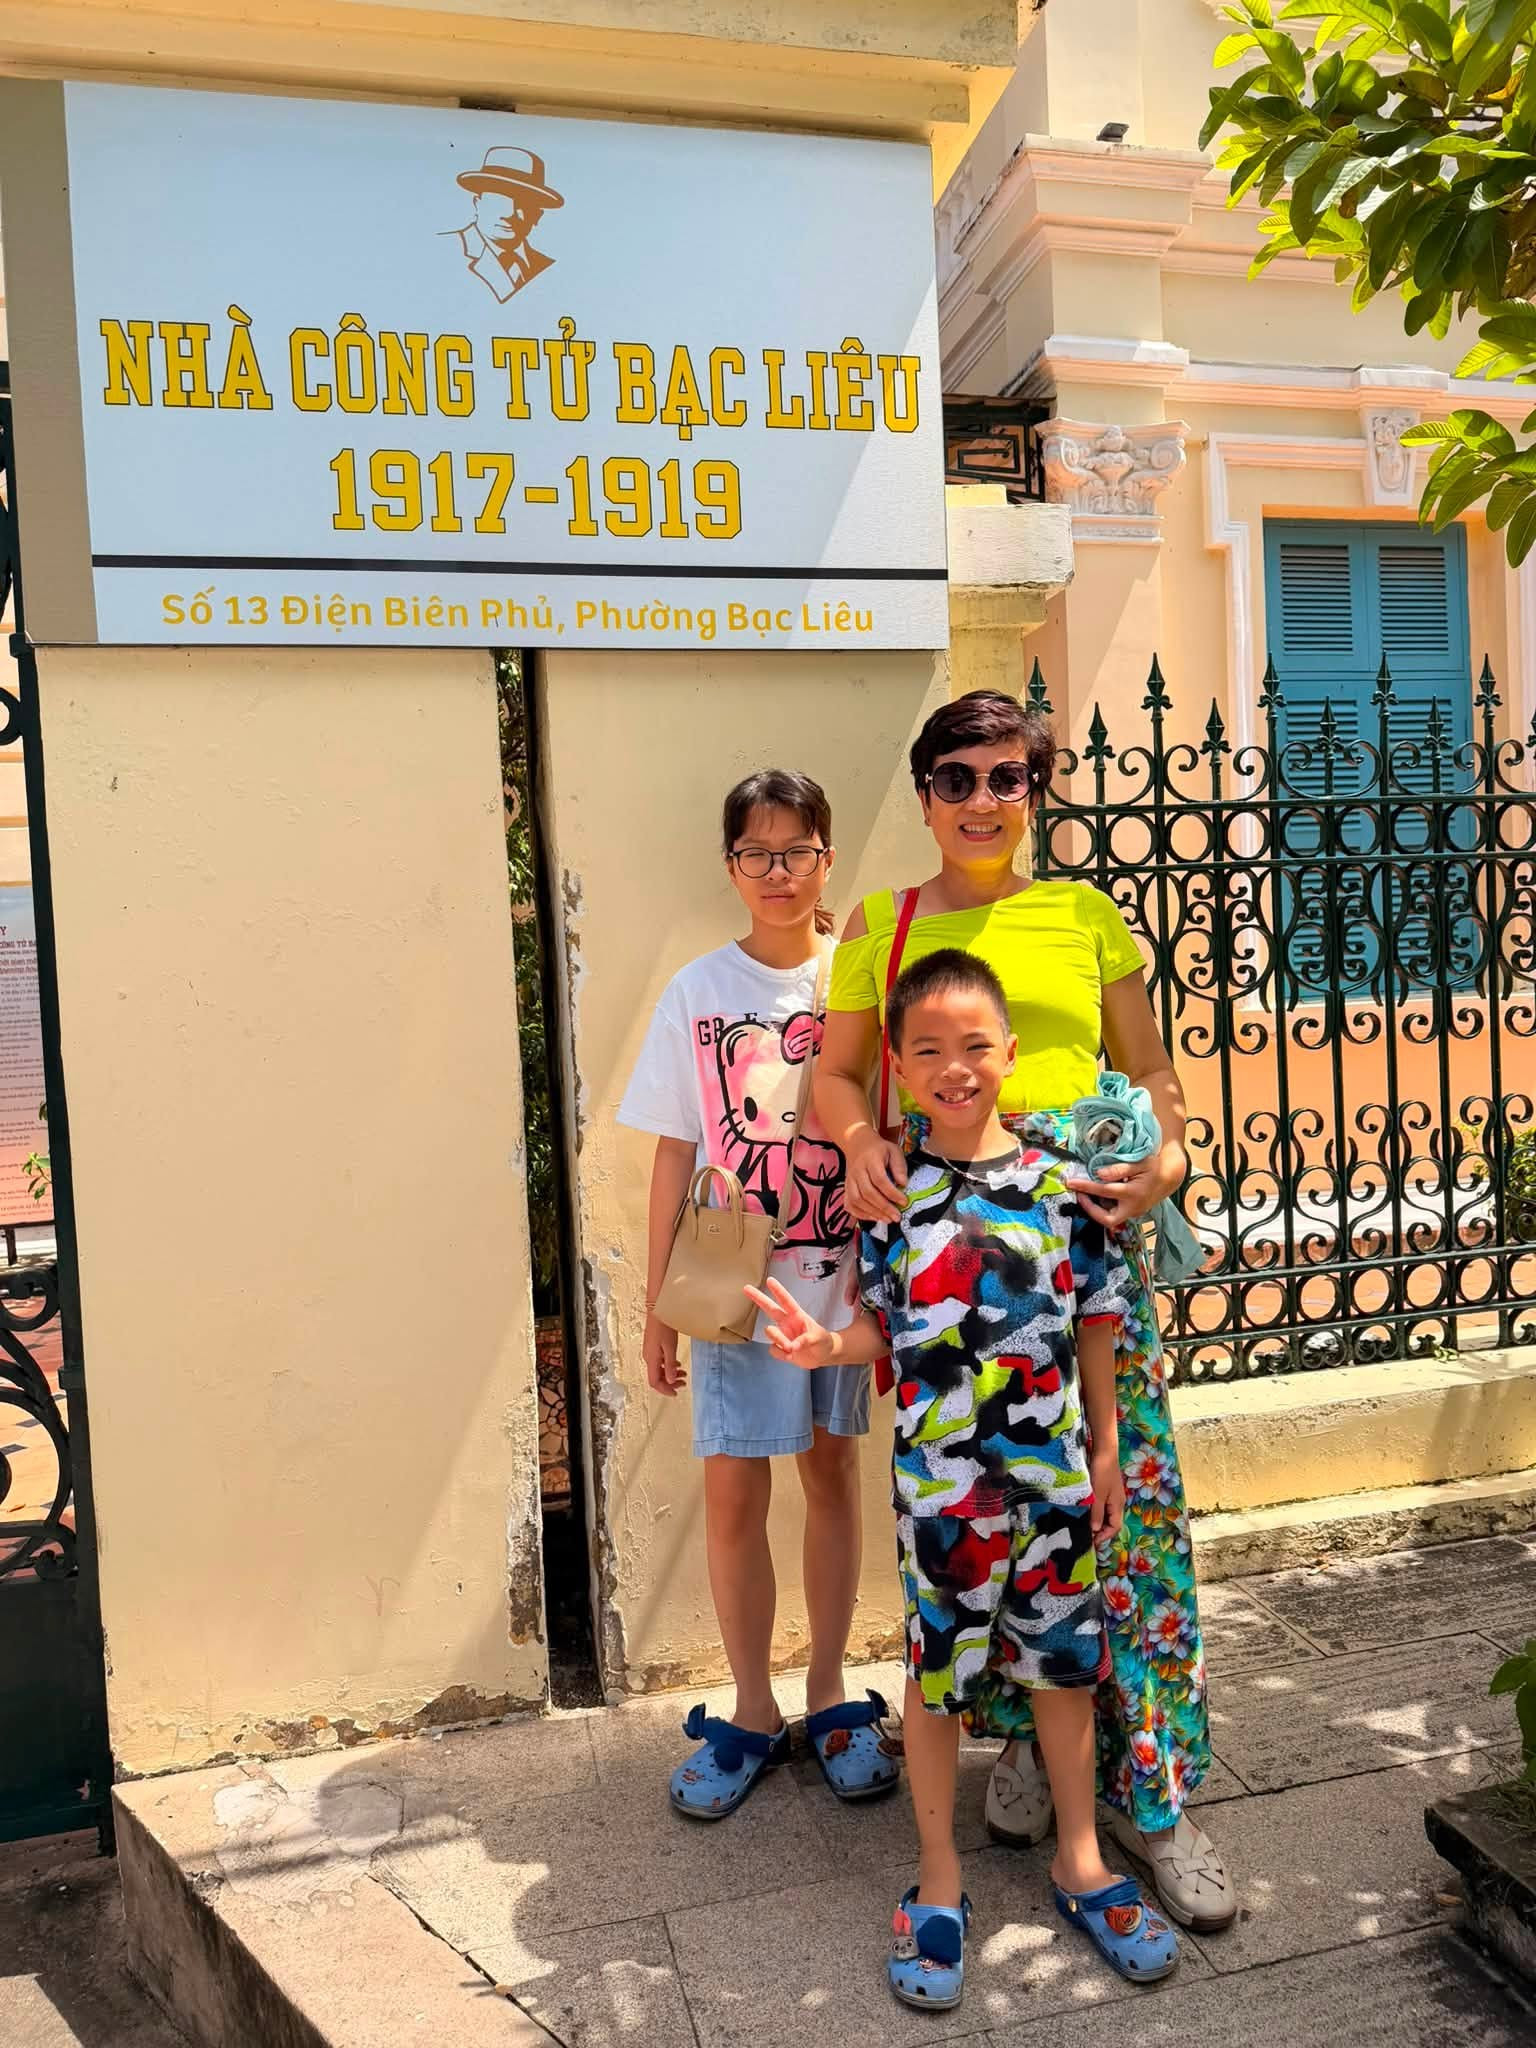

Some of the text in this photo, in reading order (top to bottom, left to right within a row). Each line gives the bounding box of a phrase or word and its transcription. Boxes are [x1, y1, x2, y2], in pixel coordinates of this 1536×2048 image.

[99, 304, 921, 441] NHÀ CÔNG TỬ BẠC LIÊU
[329, 448, 742, 539] 1917-1919
[162, 586, 873, 641] Số 13 Điện Biên Phủ, Phường Bạc Liêu
